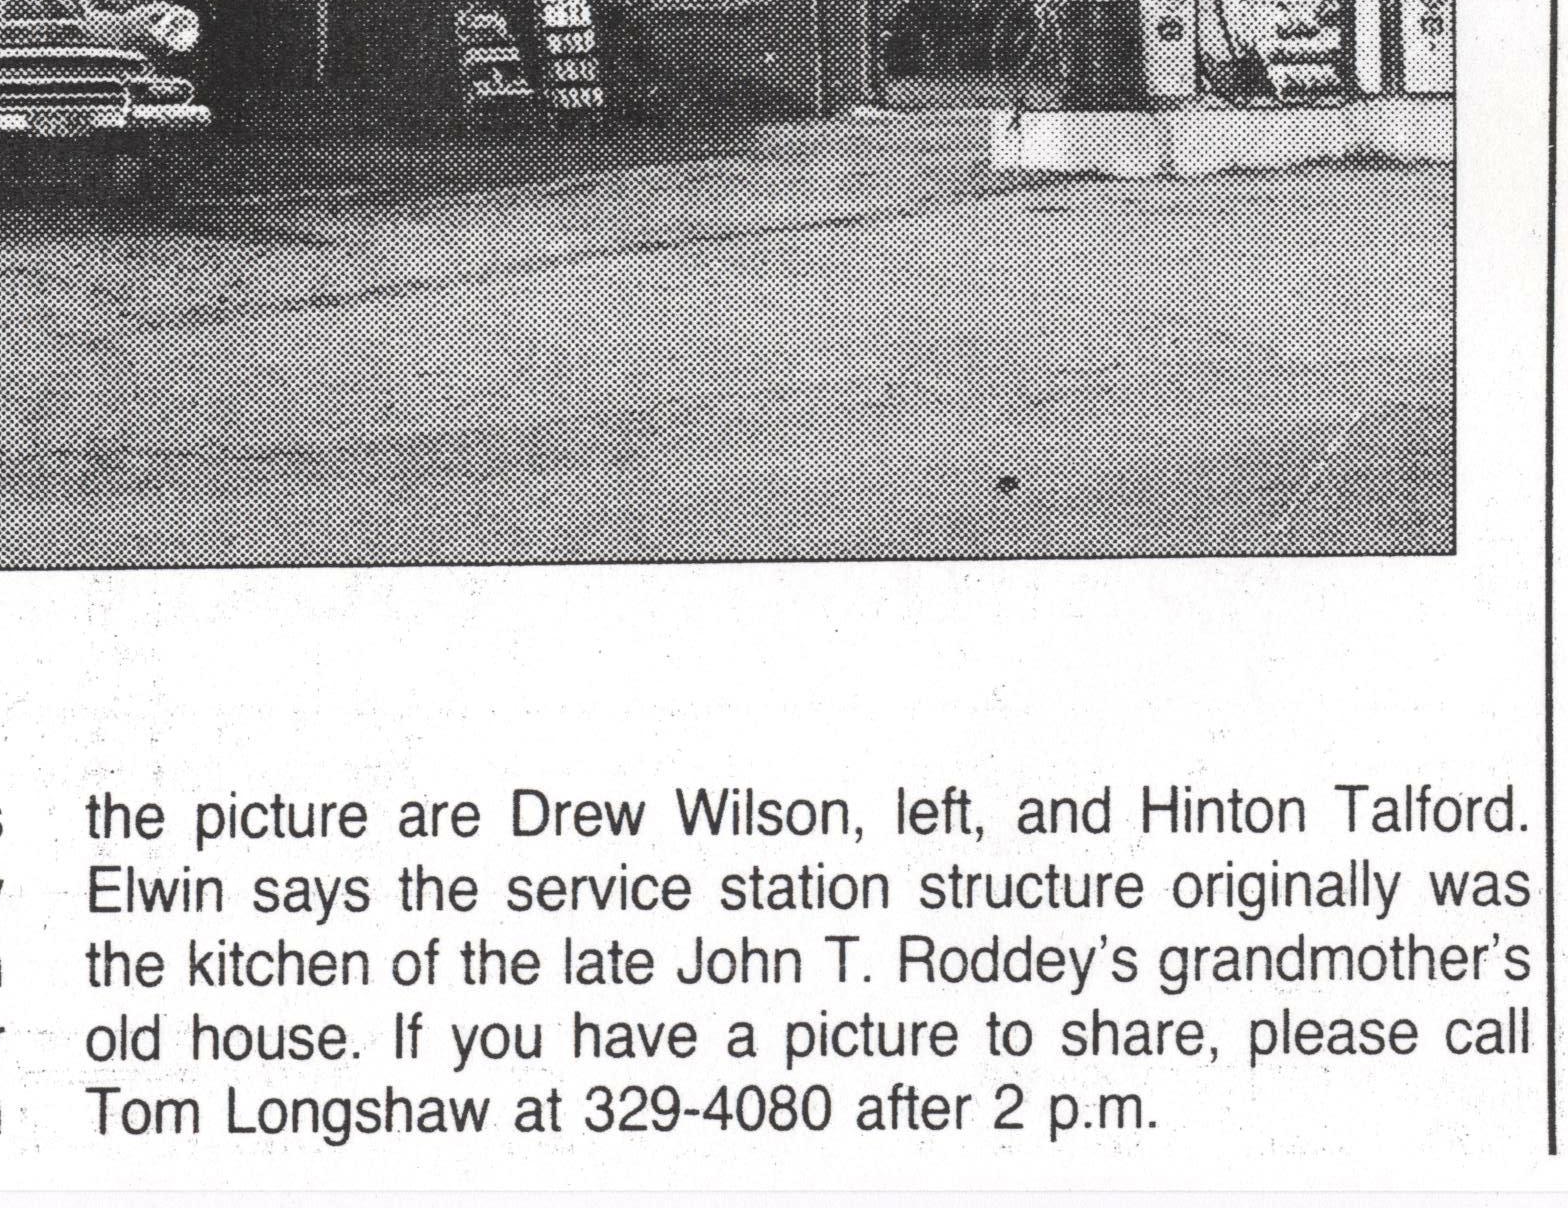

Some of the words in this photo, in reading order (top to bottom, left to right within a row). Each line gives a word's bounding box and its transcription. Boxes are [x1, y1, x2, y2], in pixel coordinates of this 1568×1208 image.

[85, 791, 165, 840] the
[196, 793, 368, 852] picture
[399, 801, 481, 838] are
[512, 788, 646, 837] Drew
[675, 787, 863, 843] Wilson,
[898, 785, 984, 842] left,
[1018, 785, 1111, 835] and
[1143, 785, 1305, 834] Hinton
[1334, 784, 1528, 833] Talford.
[89, 865, 223, 913] Elwin
[253, 876, 370, 926] says
[398, 864, 478, 912] the
[507, 874, 691, 912] service
[720, 865, 889, 911] station
[920, 864, 1144, 910] structure
[1173, 859, 1401, 921] originally
[1429, 870, 1530, 907] was
[85, 940, 164, 988] the
[189, 939, 369, 987] kitchen
[392, 937, 440, 986] of
[460, 938, 540, 986] the
[565, 937, 654, 985] late
[677, 936, 802, 985] John
[824, 935, 871, 983] T.
[899, 934, 1138, 996] Roddey's
[1159, 933, 1530, 995] grandmother's
[86, 1013, 160, 1062] old
[192, 1013, 360, 1061] house.
[395, 1011, 423, 1059] If
[451, 1023, 542, 1073] you
[574, 1011, 697, 1059] have
[727, 1021, 757, 1058] a
[786, 1012, 958, 1071] picture
[986, 1011, 1033, 1057] to
[1062, 1008, 1218, 1063] share,
[1250, 1007, 1418, 1068] please
[1445, 1006, 1529, 1055] call
[85, 1086, 200, 1135] Tom
[228, 1085, 490, 1147] Longshaw
[514, 1088, 562, 1133] at
[585, 1084, 832, 1133] 329-4080
[856, 1082, 972, 1131] after
[994, 1083, 1024, 1130] 2
[1050, 1094, 1156, 1143] p.m.
